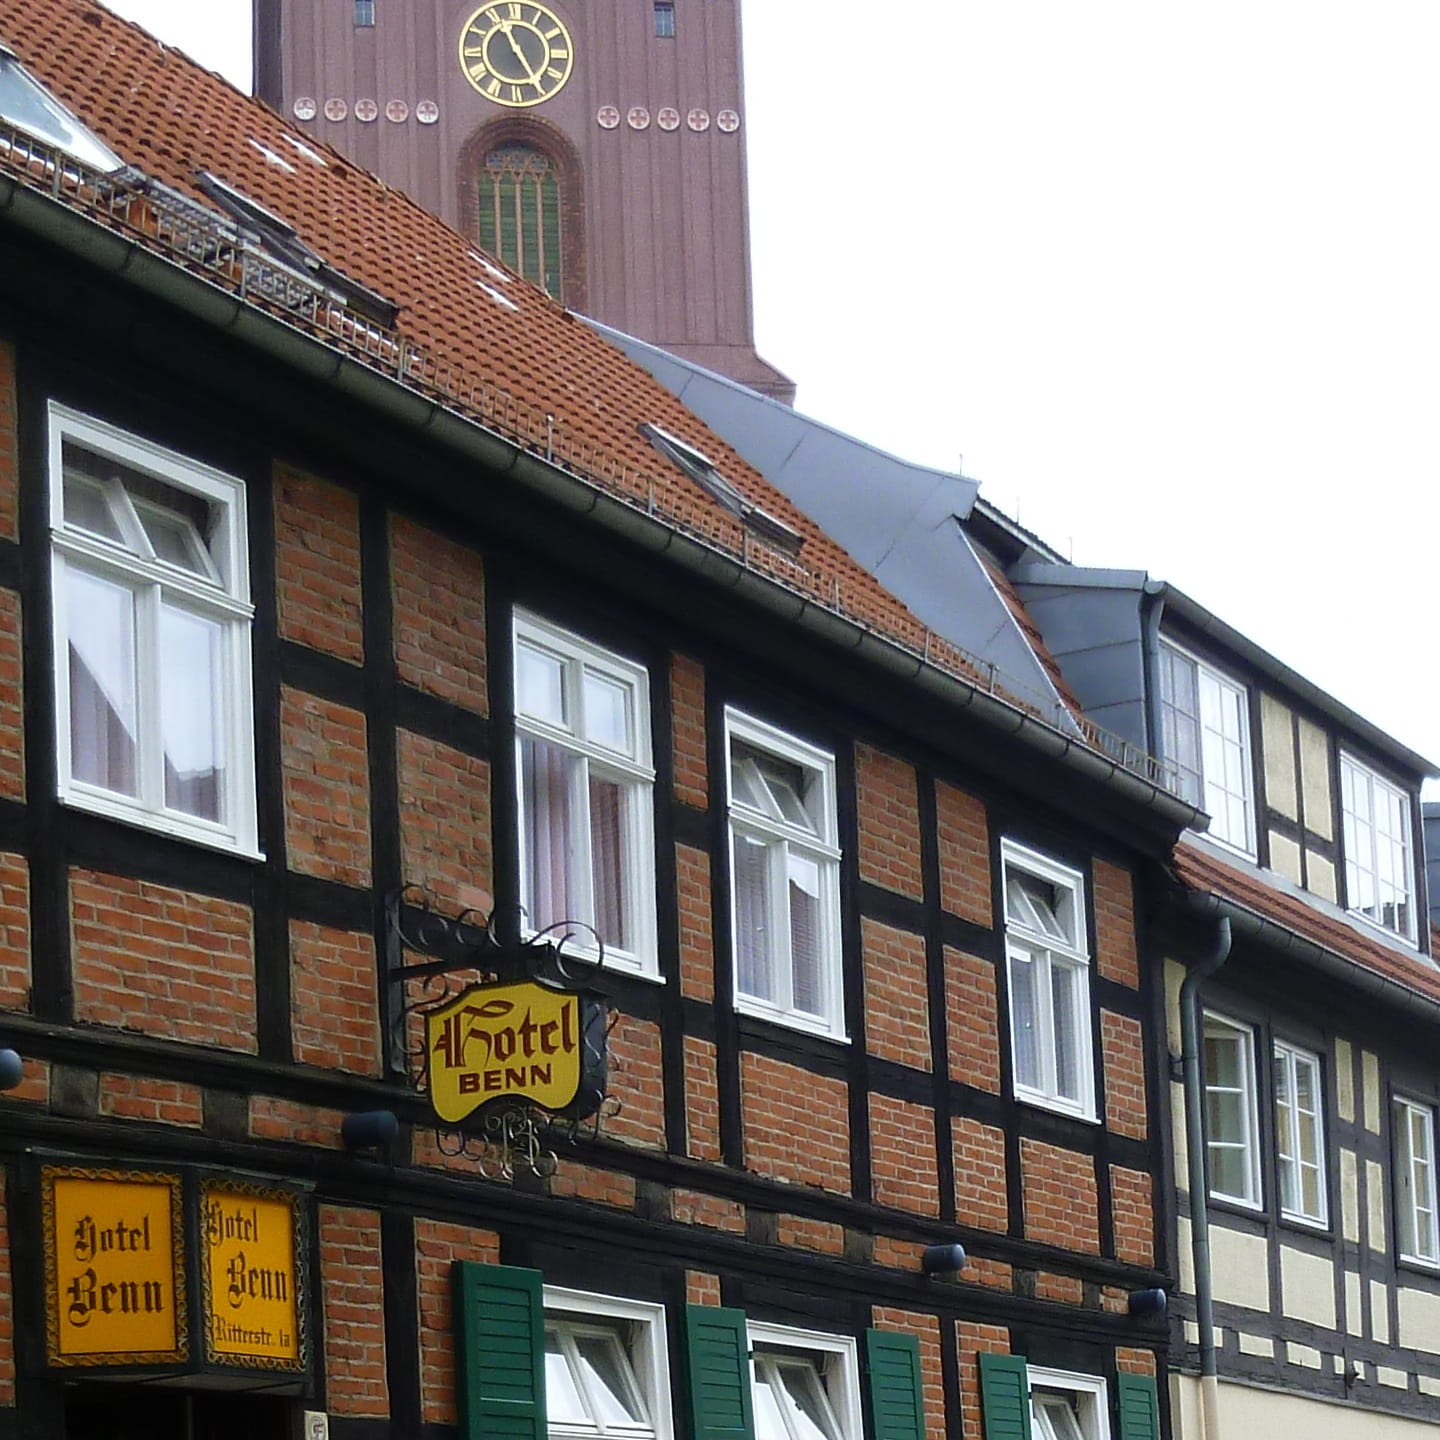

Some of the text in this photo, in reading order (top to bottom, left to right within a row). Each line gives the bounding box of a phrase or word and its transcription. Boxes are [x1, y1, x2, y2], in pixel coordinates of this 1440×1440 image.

[432, 1000, 576, 1068] Hotel
[459, 1063, 552, 1094] BENN
[74, 1213, 151, 1263] Hotel
[208, 1200, 259, 1248] Hotel
[67, 1268, 165, 1328] Benn
[226, 1250, 289, 1309] Benn
